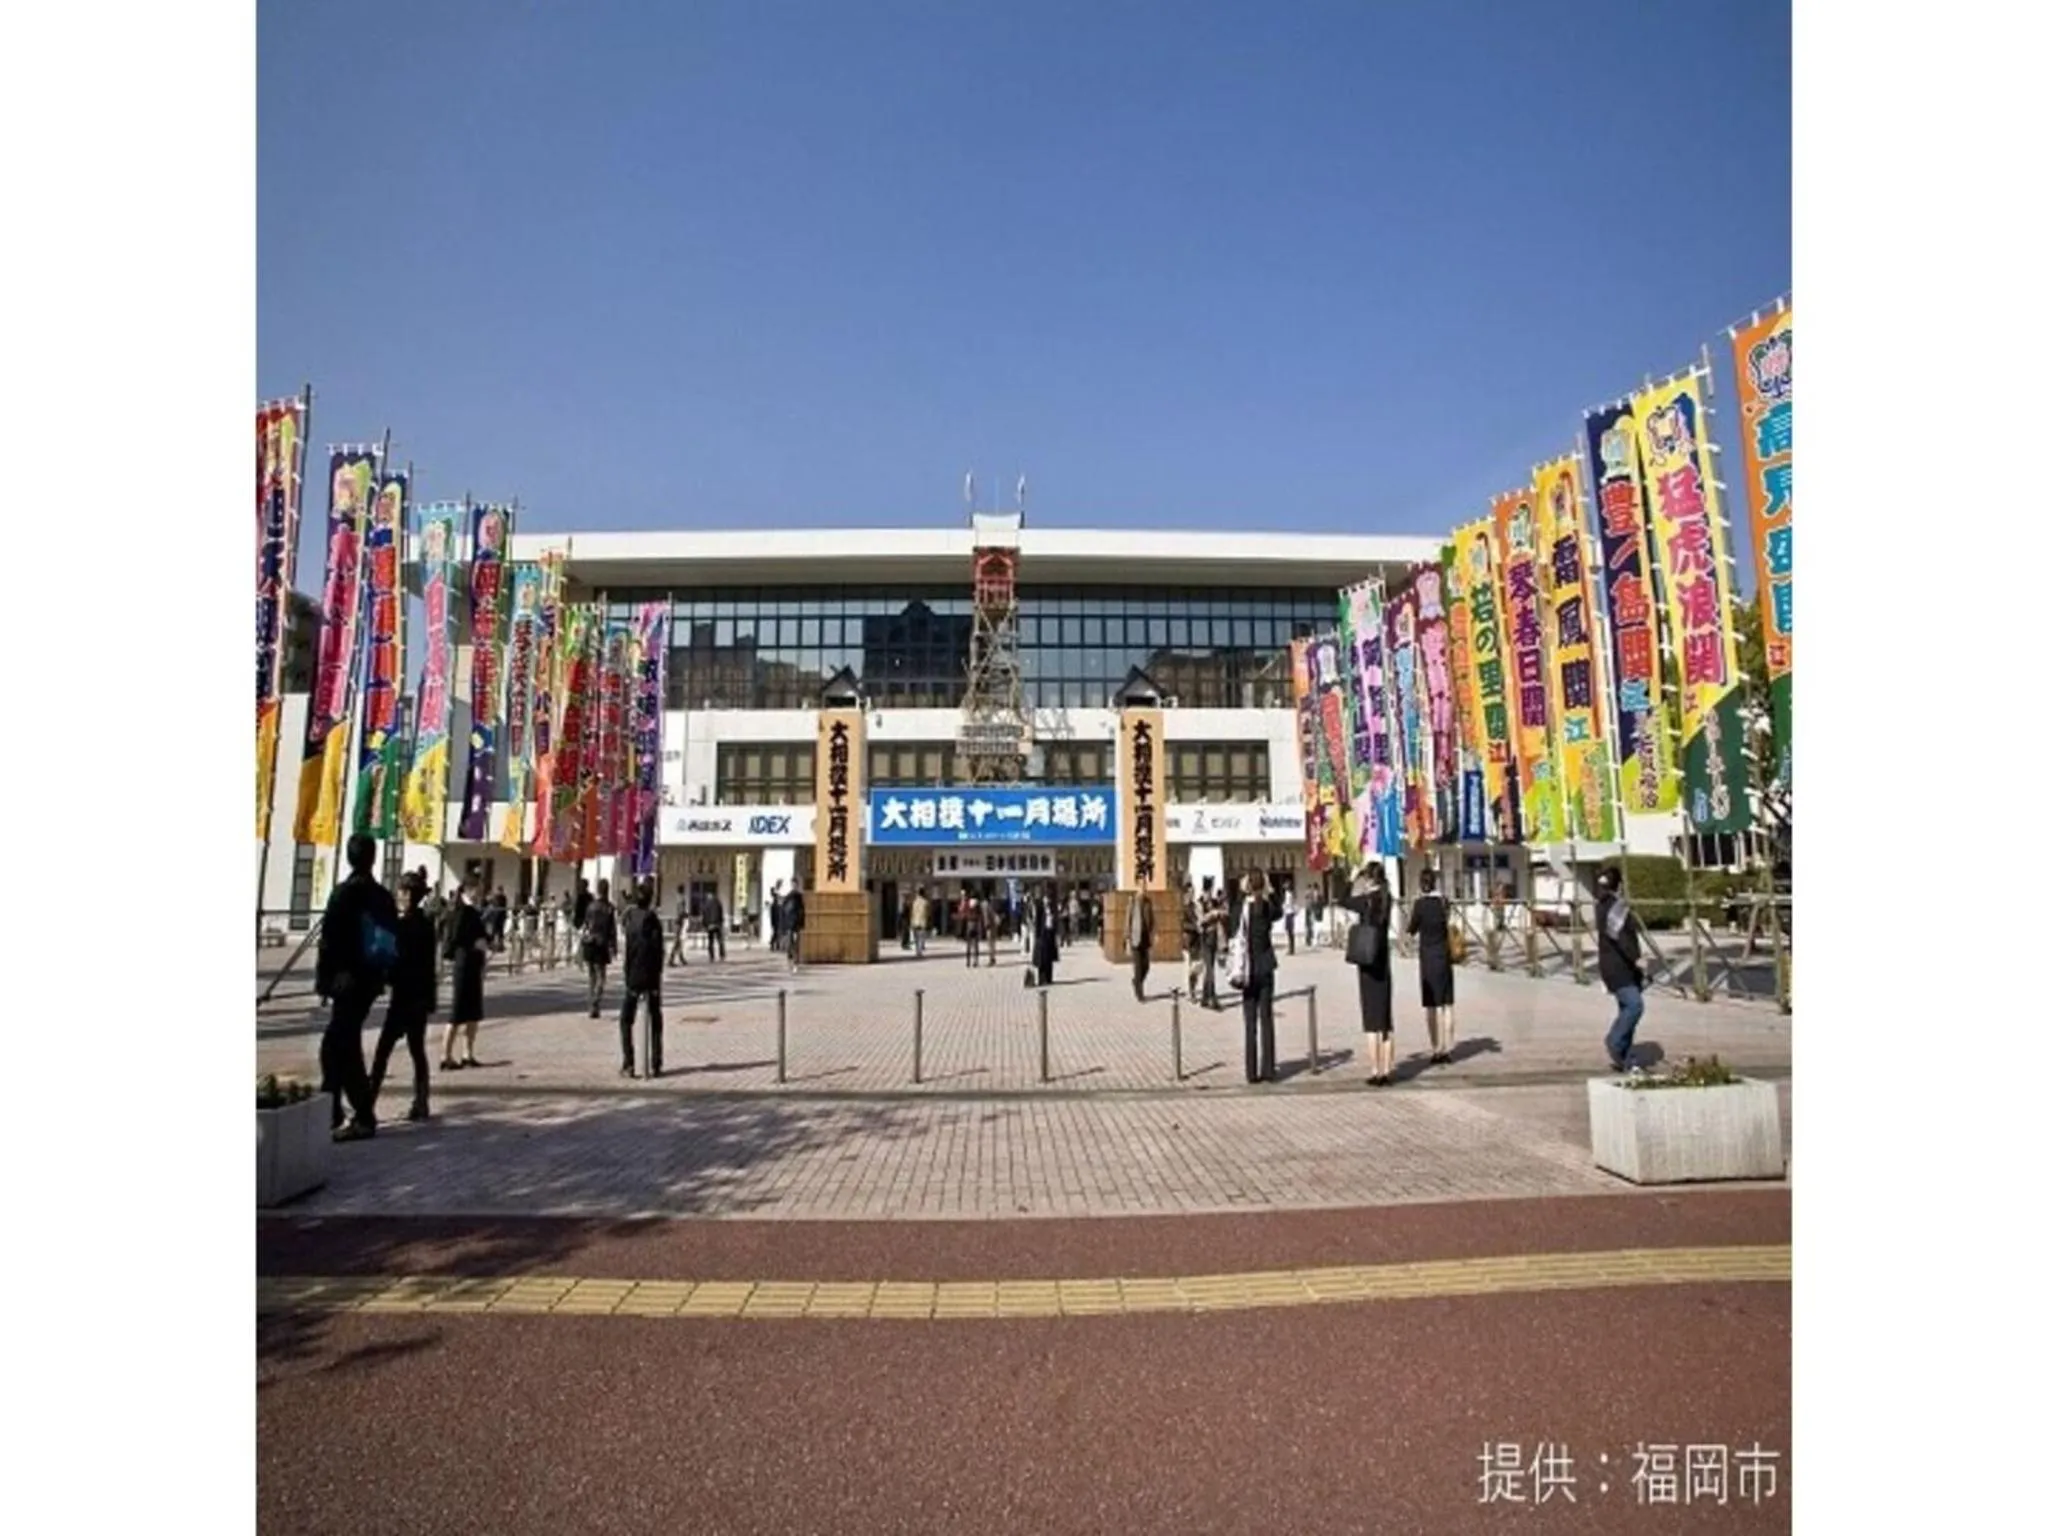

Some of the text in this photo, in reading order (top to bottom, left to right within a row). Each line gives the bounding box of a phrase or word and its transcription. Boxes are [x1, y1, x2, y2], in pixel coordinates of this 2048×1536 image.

[748, 815, 791, 834] IDEX
[828, 720, 848, 882] 大相撲十一月場所
[880, 793, 1107, 830] 大相撲十一月場所
[1134, 720, 1154, 882] 大相撲十一月場所
